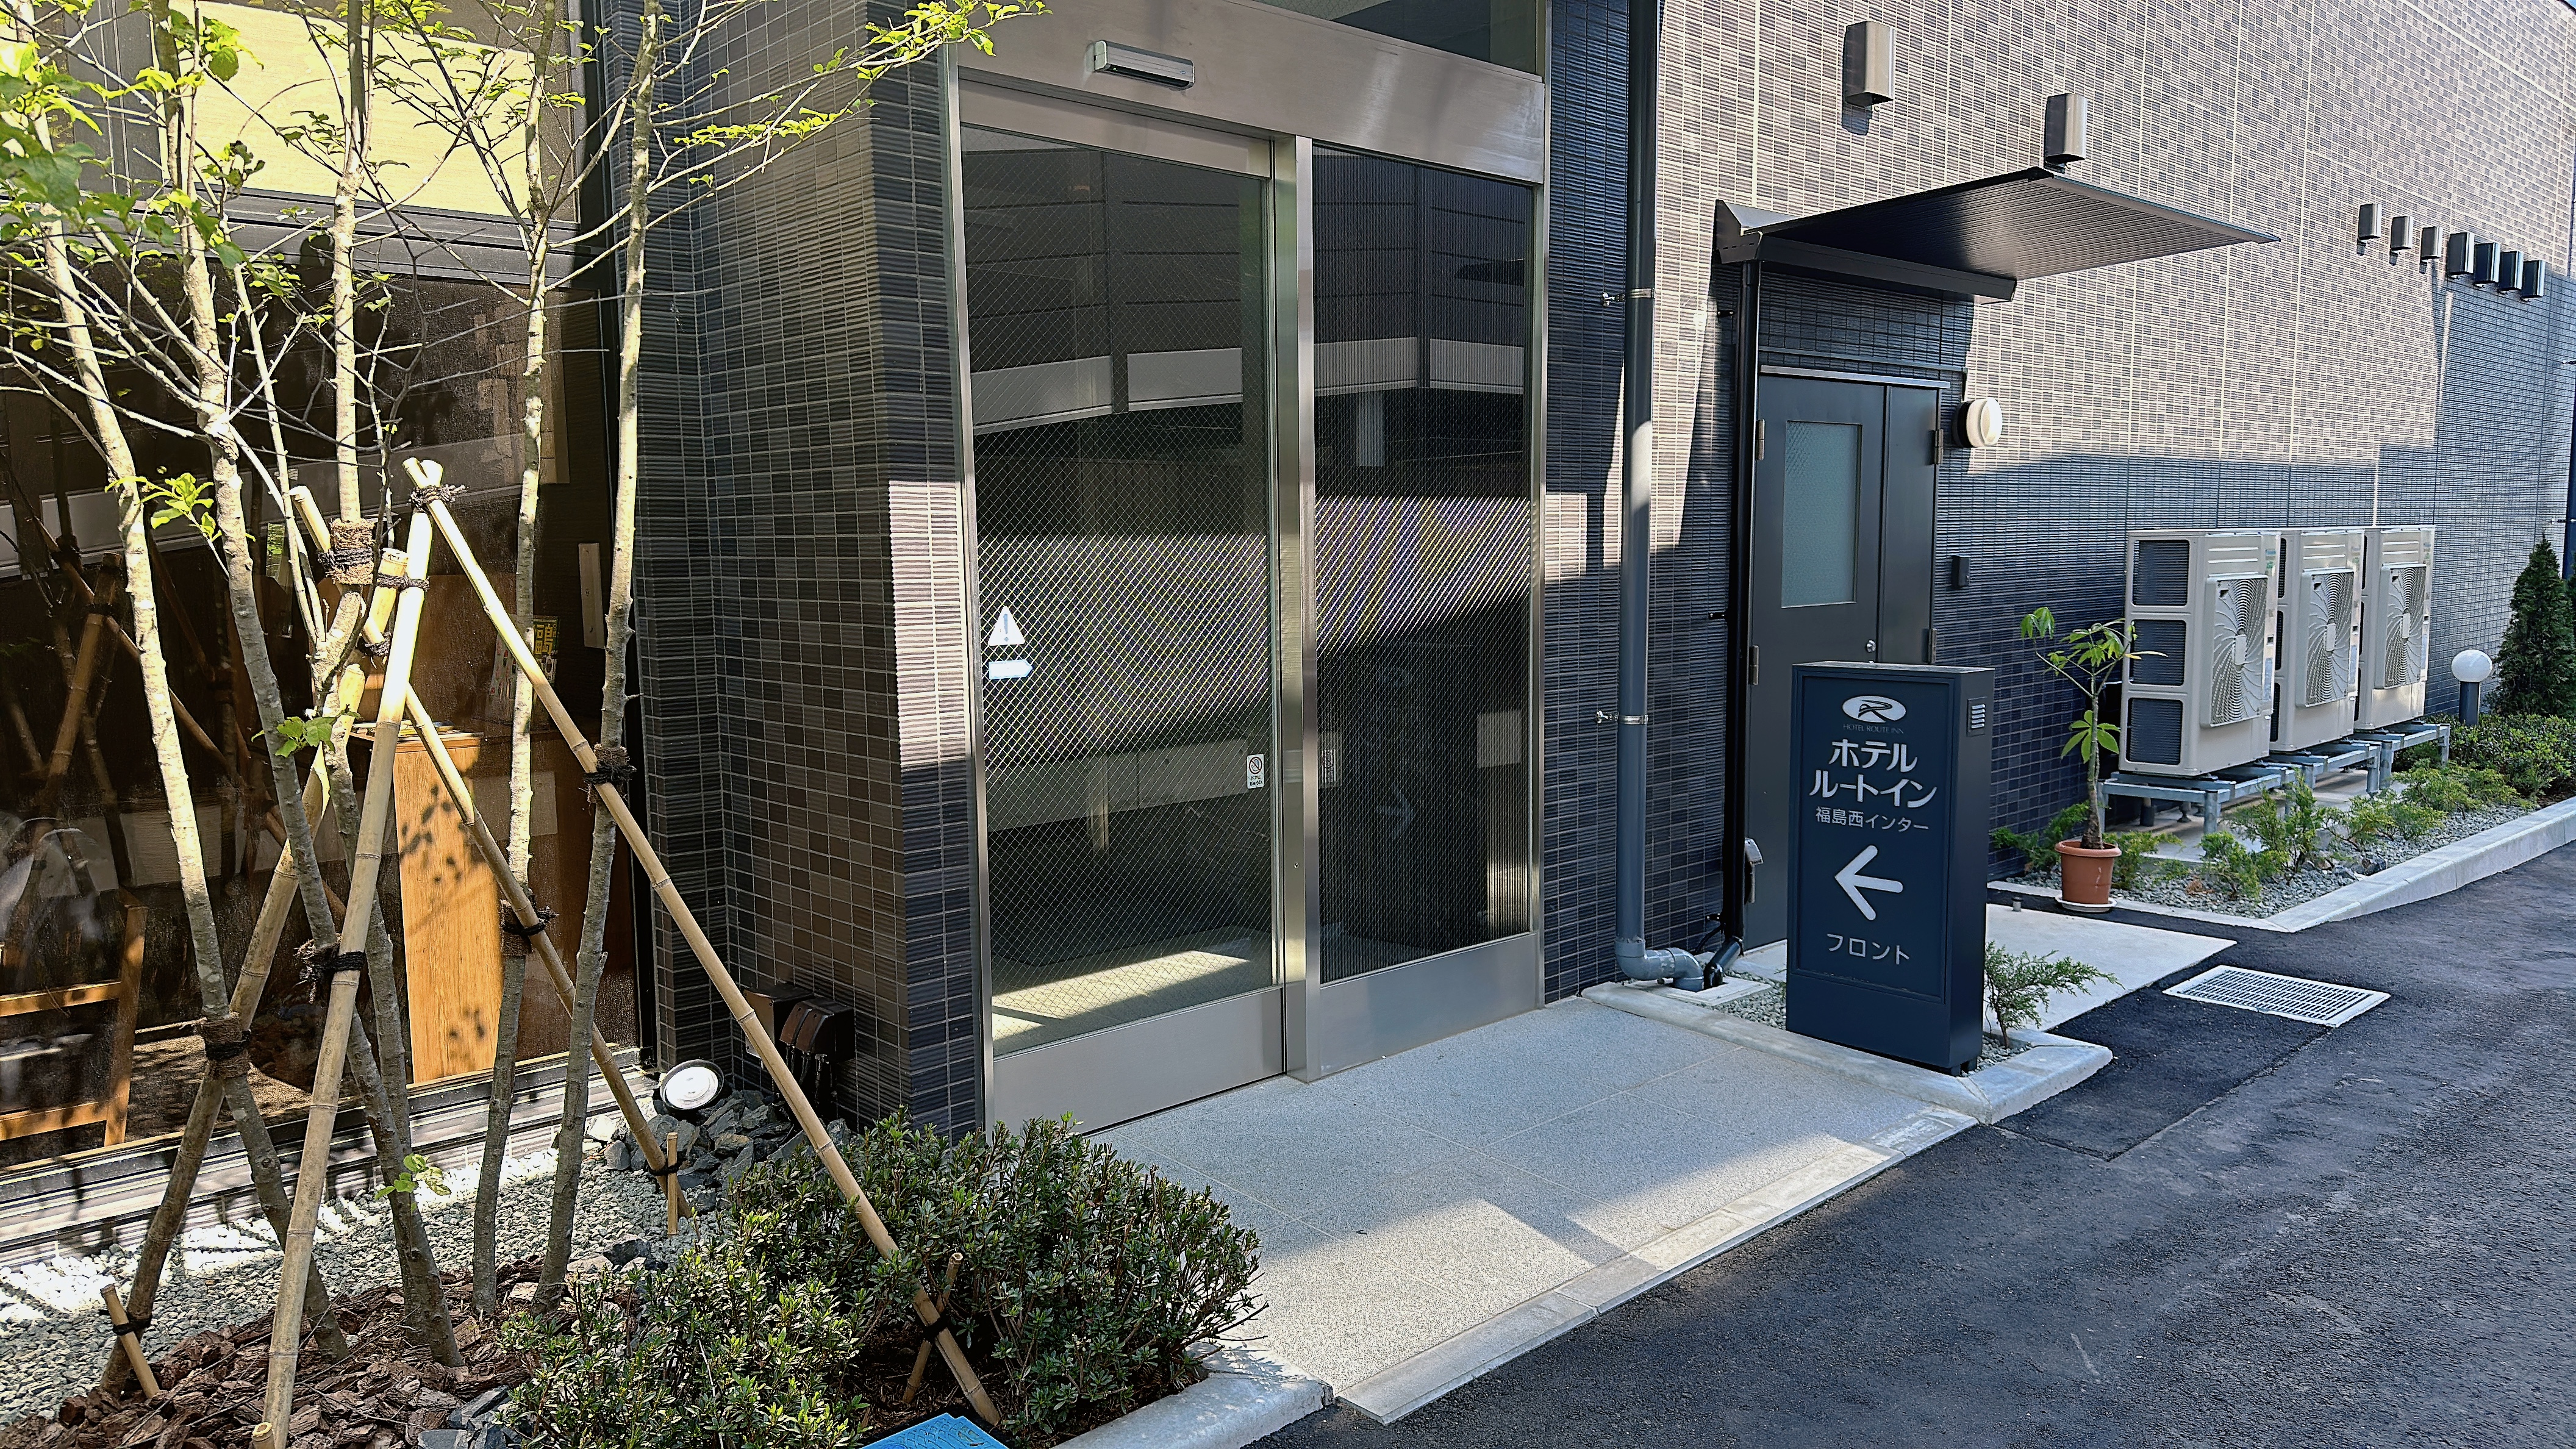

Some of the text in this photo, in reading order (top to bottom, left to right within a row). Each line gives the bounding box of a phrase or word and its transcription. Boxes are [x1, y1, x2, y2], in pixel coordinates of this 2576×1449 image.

[1829, 739, 1917, 772] ホテル
[1809, 770, 1937, 808] ルートイン
[1816, 806, 1929, 832] 福島西インター
[1827, 933, 1910, 965] フロント
